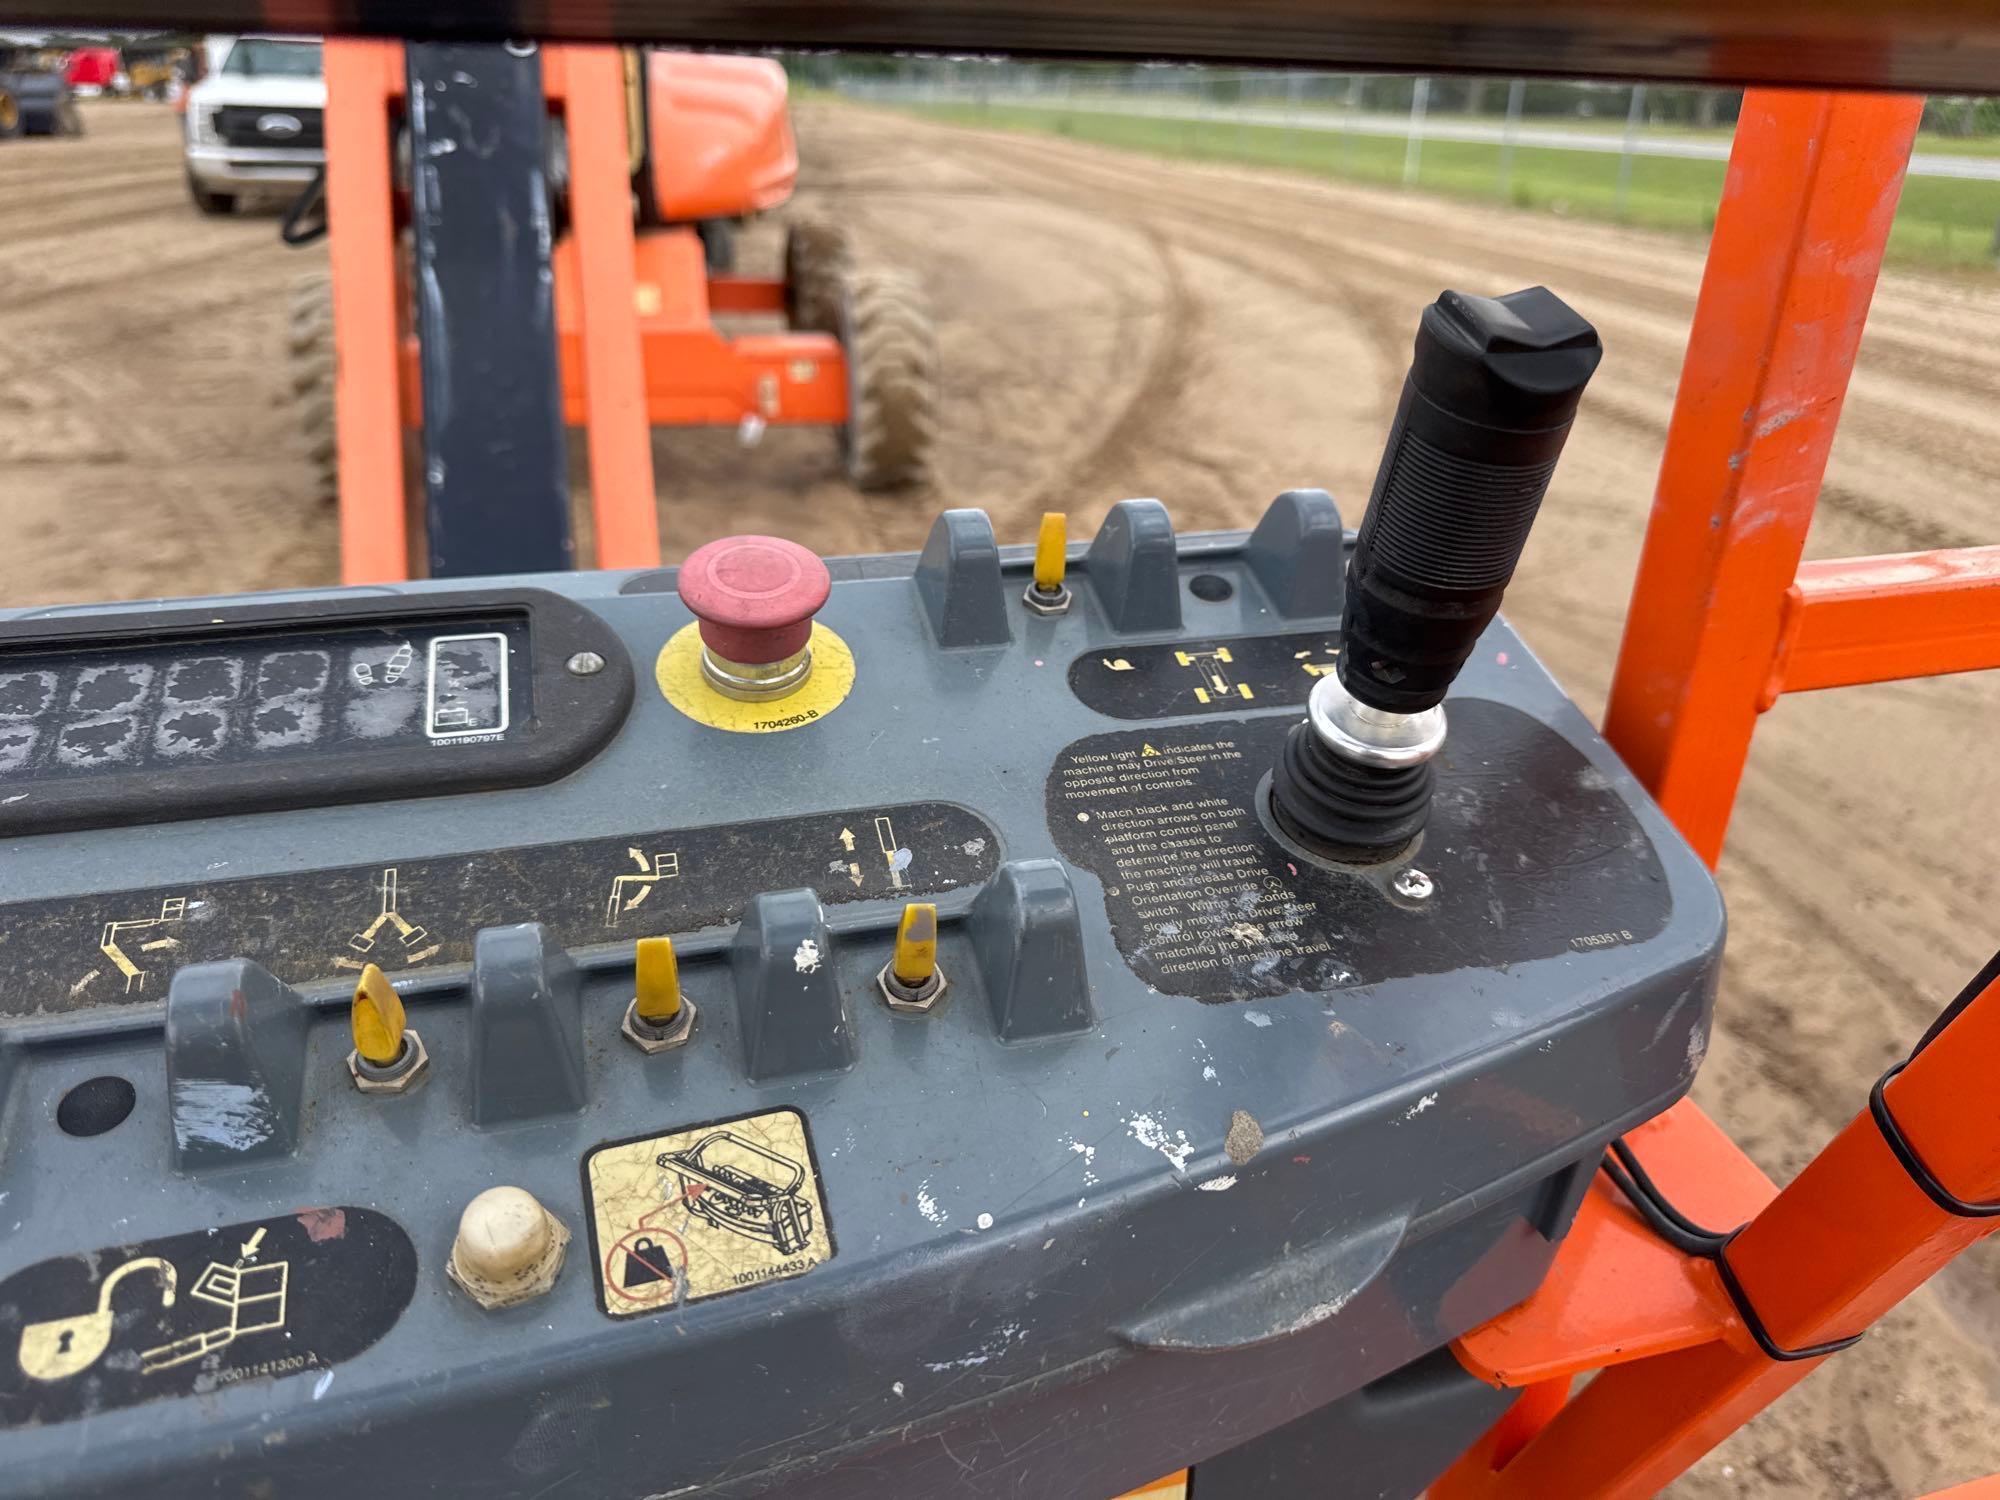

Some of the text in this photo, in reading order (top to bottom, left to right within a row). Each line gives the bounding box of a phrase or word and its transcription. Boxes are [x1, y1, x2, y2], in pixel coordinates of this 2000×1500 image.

[753, 709, 819, 730] 1704260-B
[430, 733, 505, 747] 1001190797E
[1070, 740, 1235, 764] Yellow light indicates the
[1063, 764, 1114, 776] machine
[1116, 761, 1141, 771] may
[1222, 751, 1242, 759] the
[1064, 766, 1200, 789] opposite direction from
[1065, 785, 1129, 800] movement
[1130, 782, 1143, 792] of
[1095, 798, 1229, 820] Match black and white
[1101, 807, 1246, 832] direction arrows on both
[1104, 819, 1239, 845] platform control panel
[1111, 834, 1222, 856] and the chassis to
[1116, 843, 1256, 868] determine the direction
[1120, 854, 1262, 880] the machine will travel.
[1125, 867, 1269, 894] Push and release Drive
[1131, 881, 1259, 906] Orientation Override
[1137, 905, 1182, 919] switch.
[1242, 890, 1297, 905] conds
[1186, 914, 1220, 927] move
[1224, 909, 1246, 921] the
[1149, 930, 1195, 946] control
[1267, 916, 1304, 930] arrow
[1620, 929, 1633, 940] B
[1154, 944, 1217, 960] matching
[1218, 940, 1239, 950] the
[1160, 940, 1335, 974] direction of machine travel.
[732, 1256, 818, 1285] 1001144433 A
[306, 1350, 318, 1365] A
